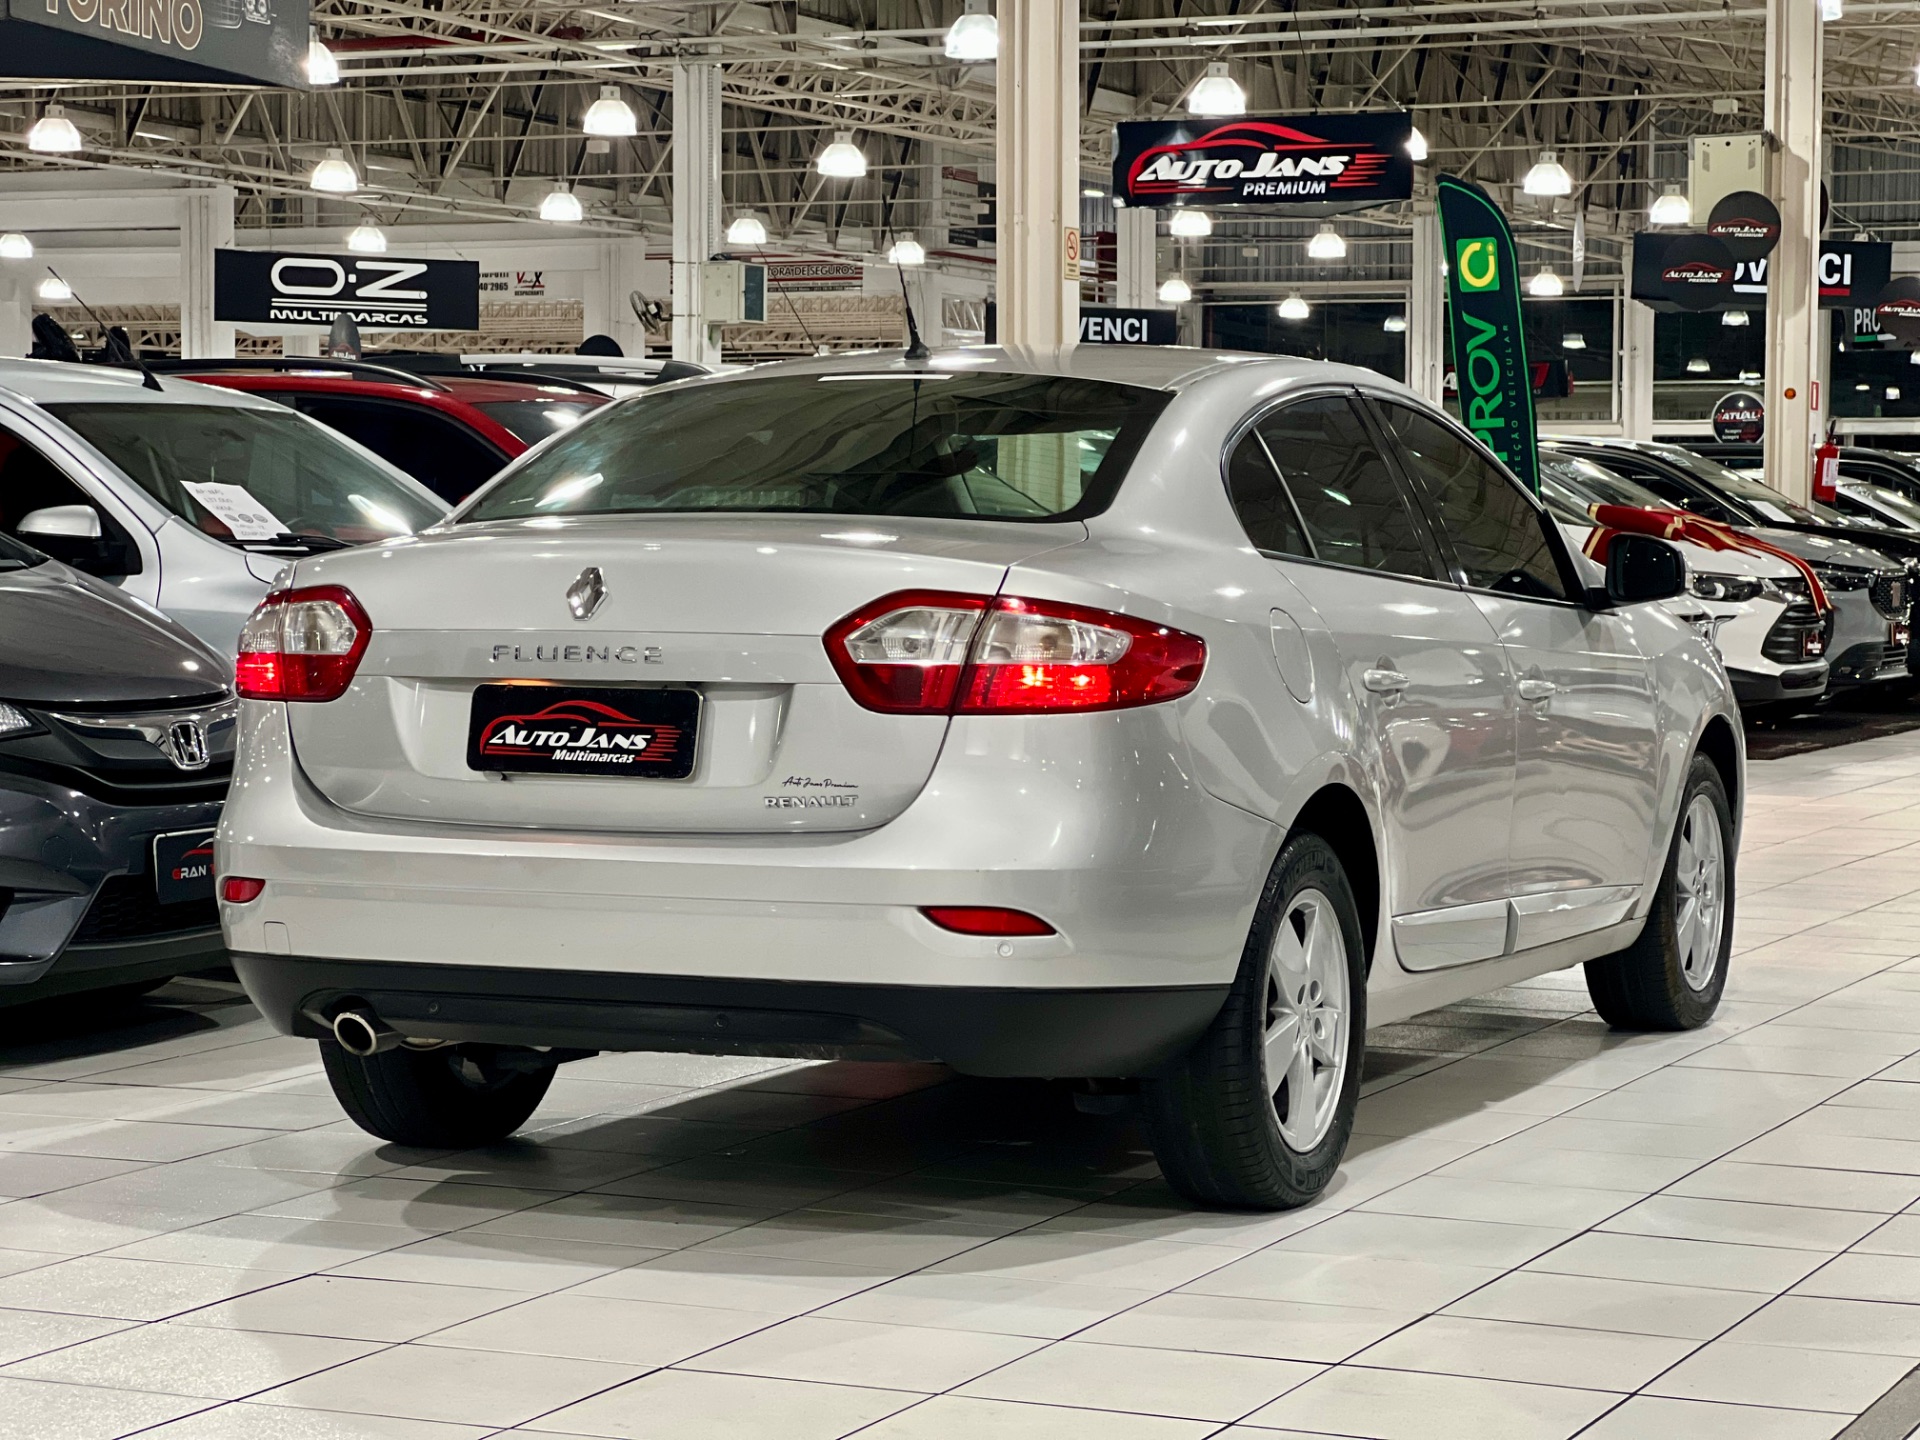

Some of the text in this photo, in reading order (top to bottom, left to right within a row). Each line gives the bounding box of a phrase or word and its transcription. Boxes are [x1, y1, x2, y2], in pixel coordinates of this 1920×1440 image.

[1242, 180, 1327, 197] PREMIUM
[794, 265, 807, 276] DE
[809, 263, 855, 276] SEGUROS
[1502, 324, 1518, 408] VEICULAR
[490, 644, 664, 665] FLUENCE
[551, 749, 635, 764] Multimarcas
[763, 795, 859, 809] RENAULT
[171, 864, 207, 880] GRAN
